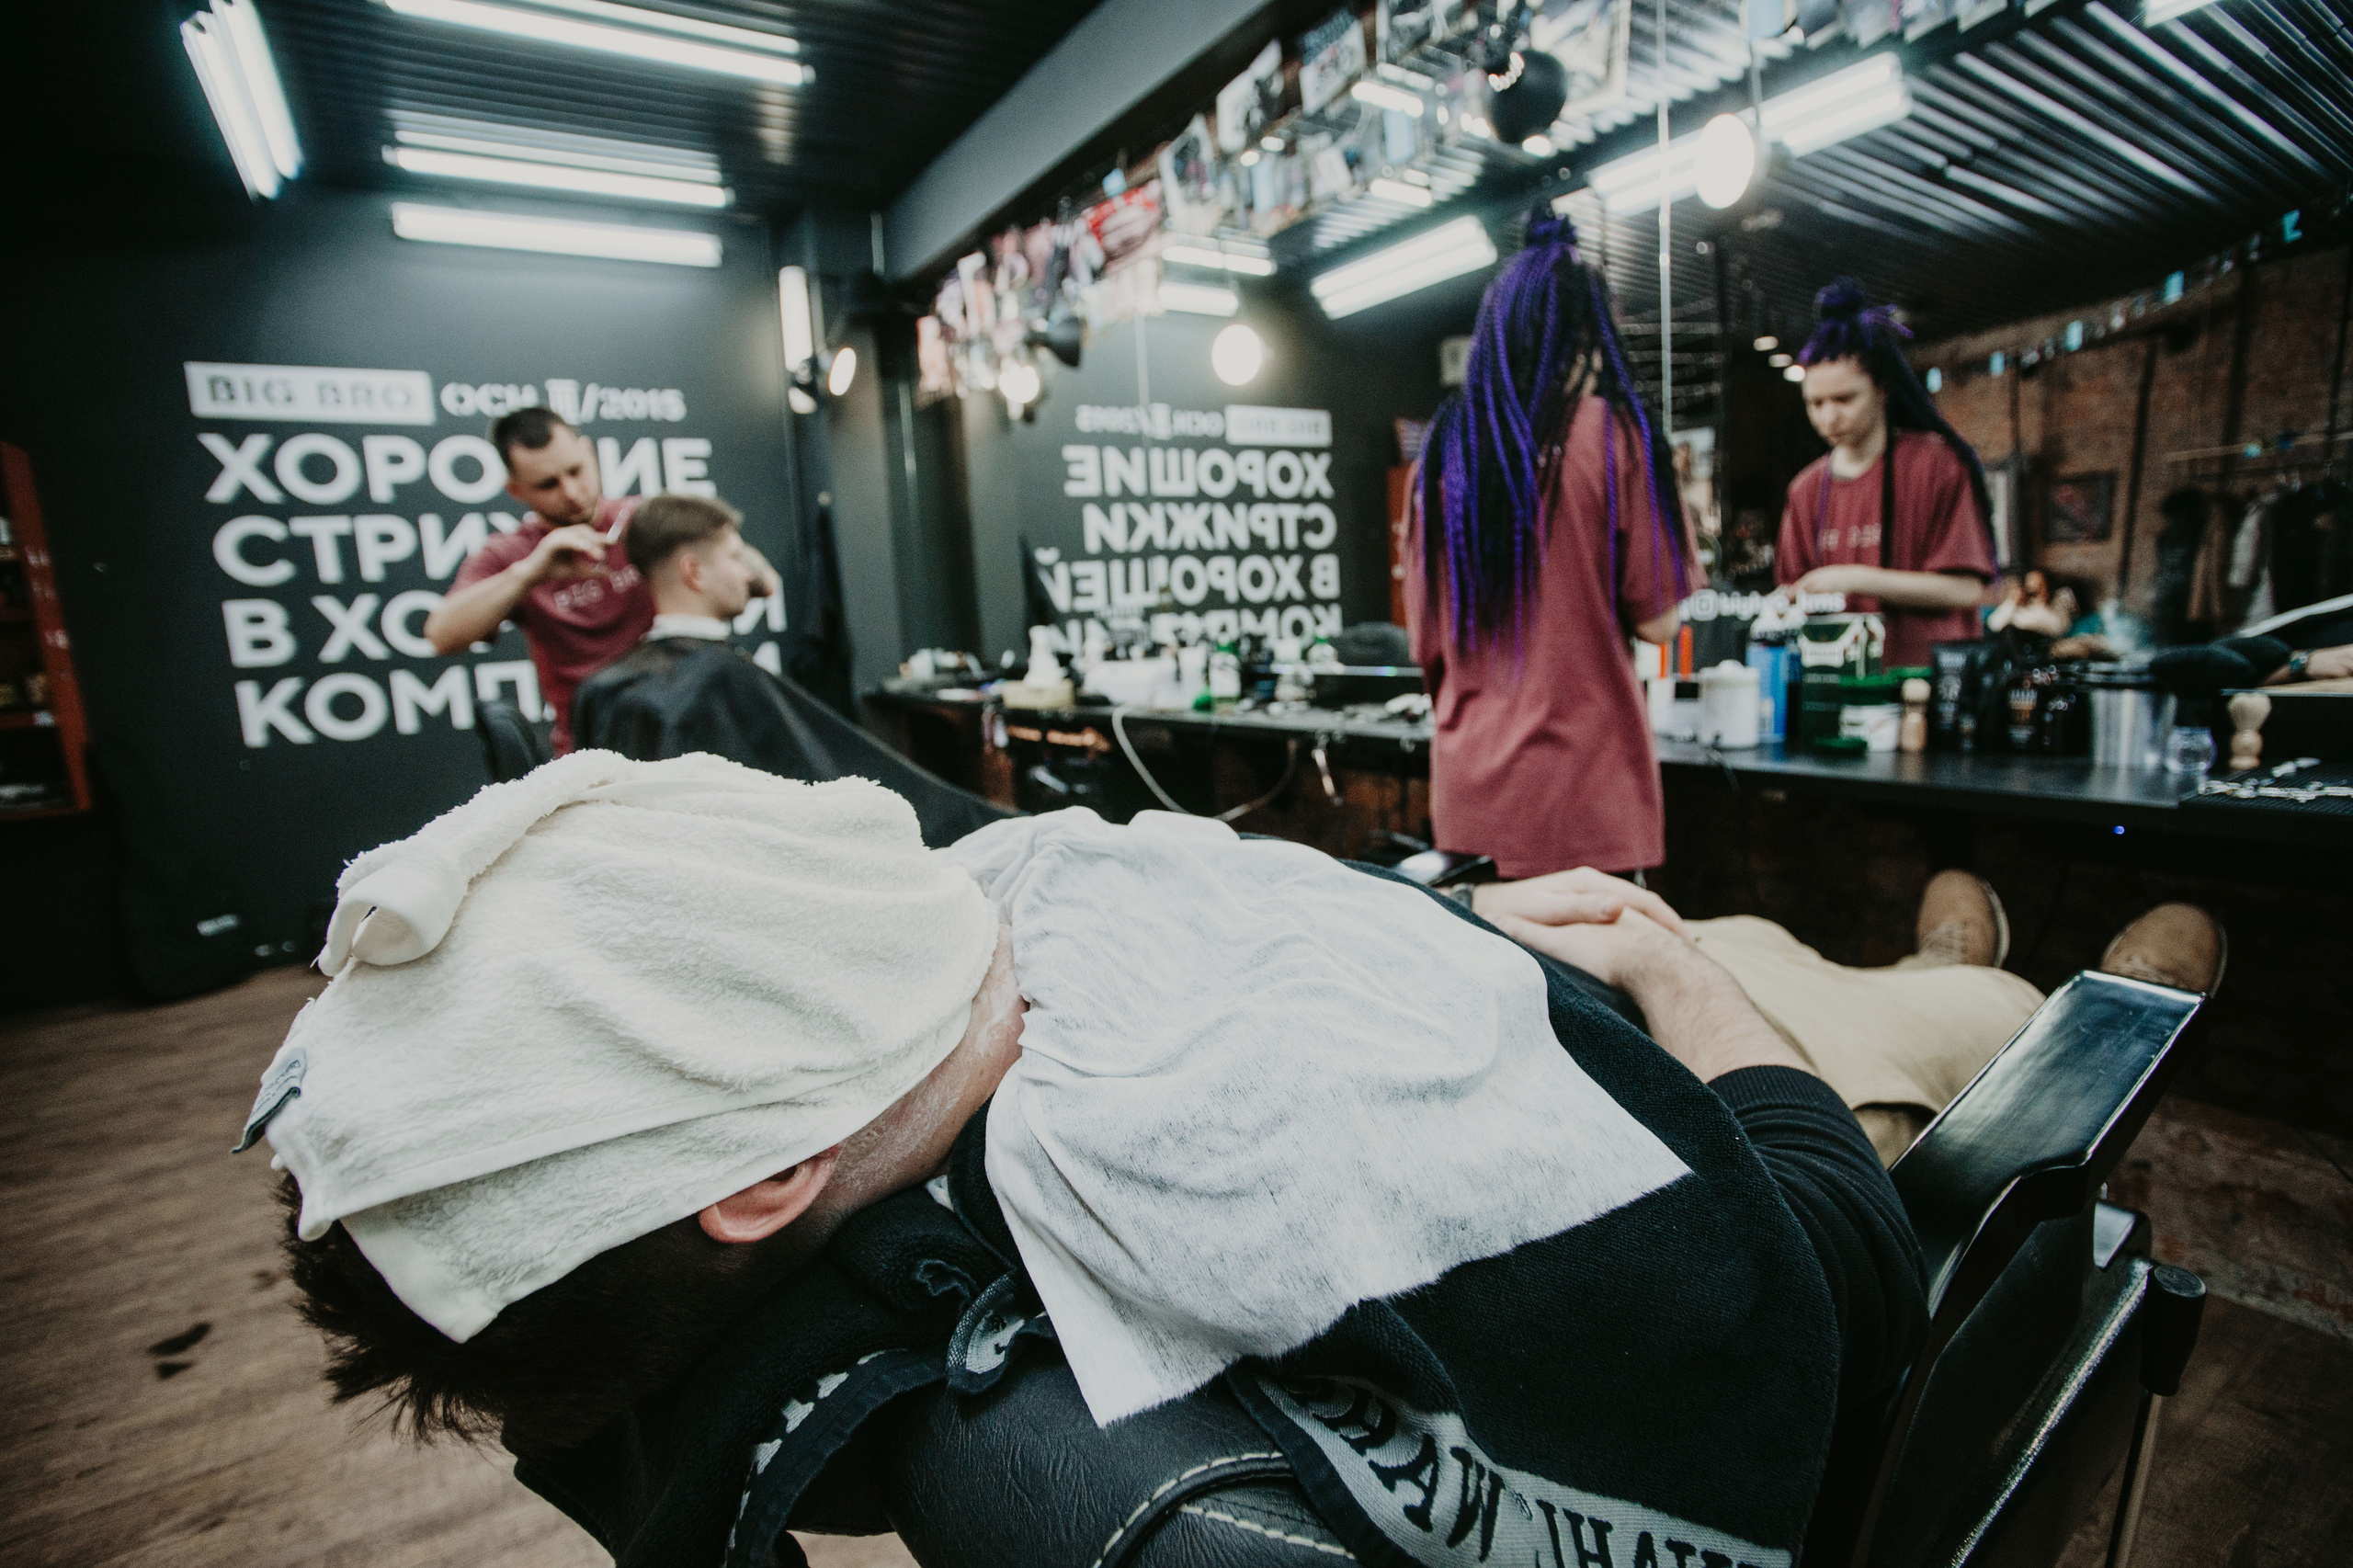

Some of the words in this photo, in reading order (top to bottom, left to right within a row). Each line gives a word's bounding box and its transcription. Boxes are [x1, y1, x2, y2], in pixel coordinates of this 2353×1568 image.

[208, 374, 293, 404] BIG
[318, 380, 411, 409] BRO
[196, 432, 718, 505] ХОРОИЕ
[212, 511, 539, 587] СТРИ
[222, 597, 297, 668] В
